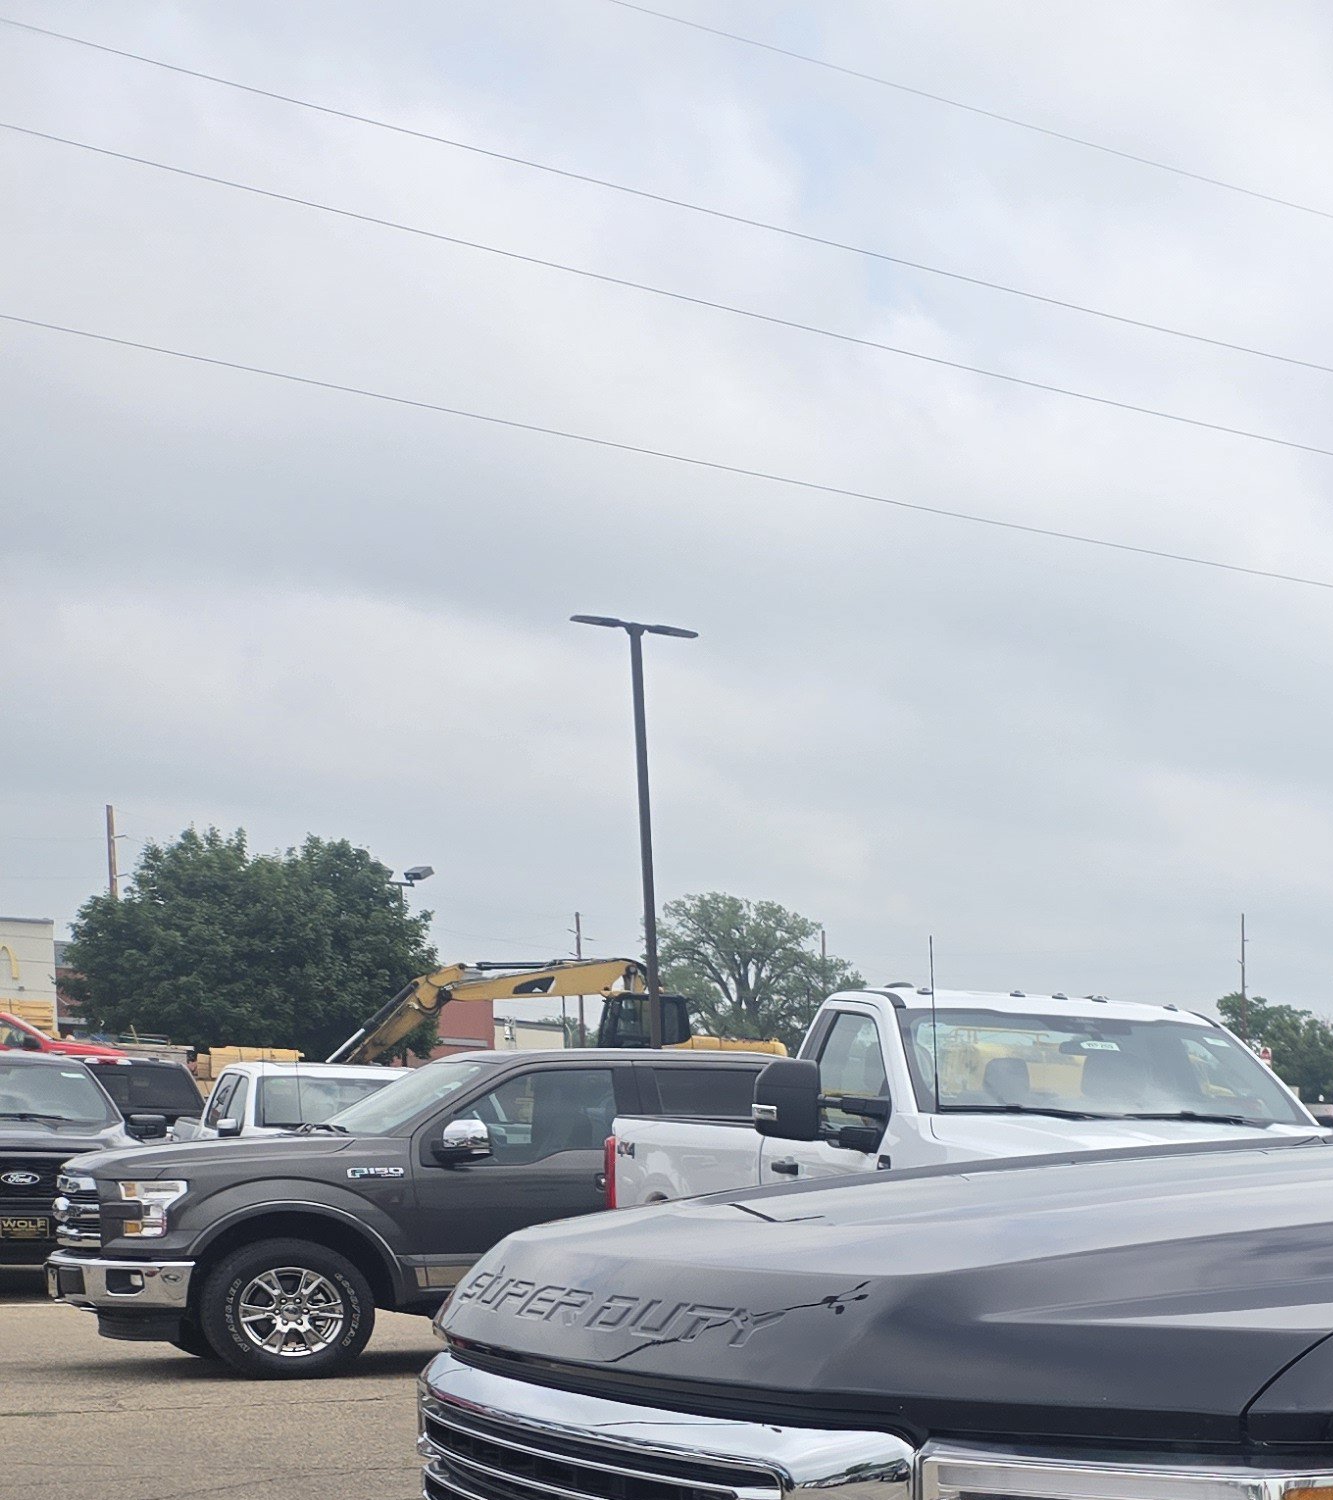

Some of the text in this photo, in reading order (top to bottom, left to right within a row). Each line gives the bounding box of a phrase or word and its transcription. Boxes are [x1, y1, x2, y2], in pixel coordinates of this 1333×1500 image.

[2, 1220, 46, 1228] WOLF
[458, 1271, 594, 1327] SUPER
[585, 1294, 788, 1348] DUTY
